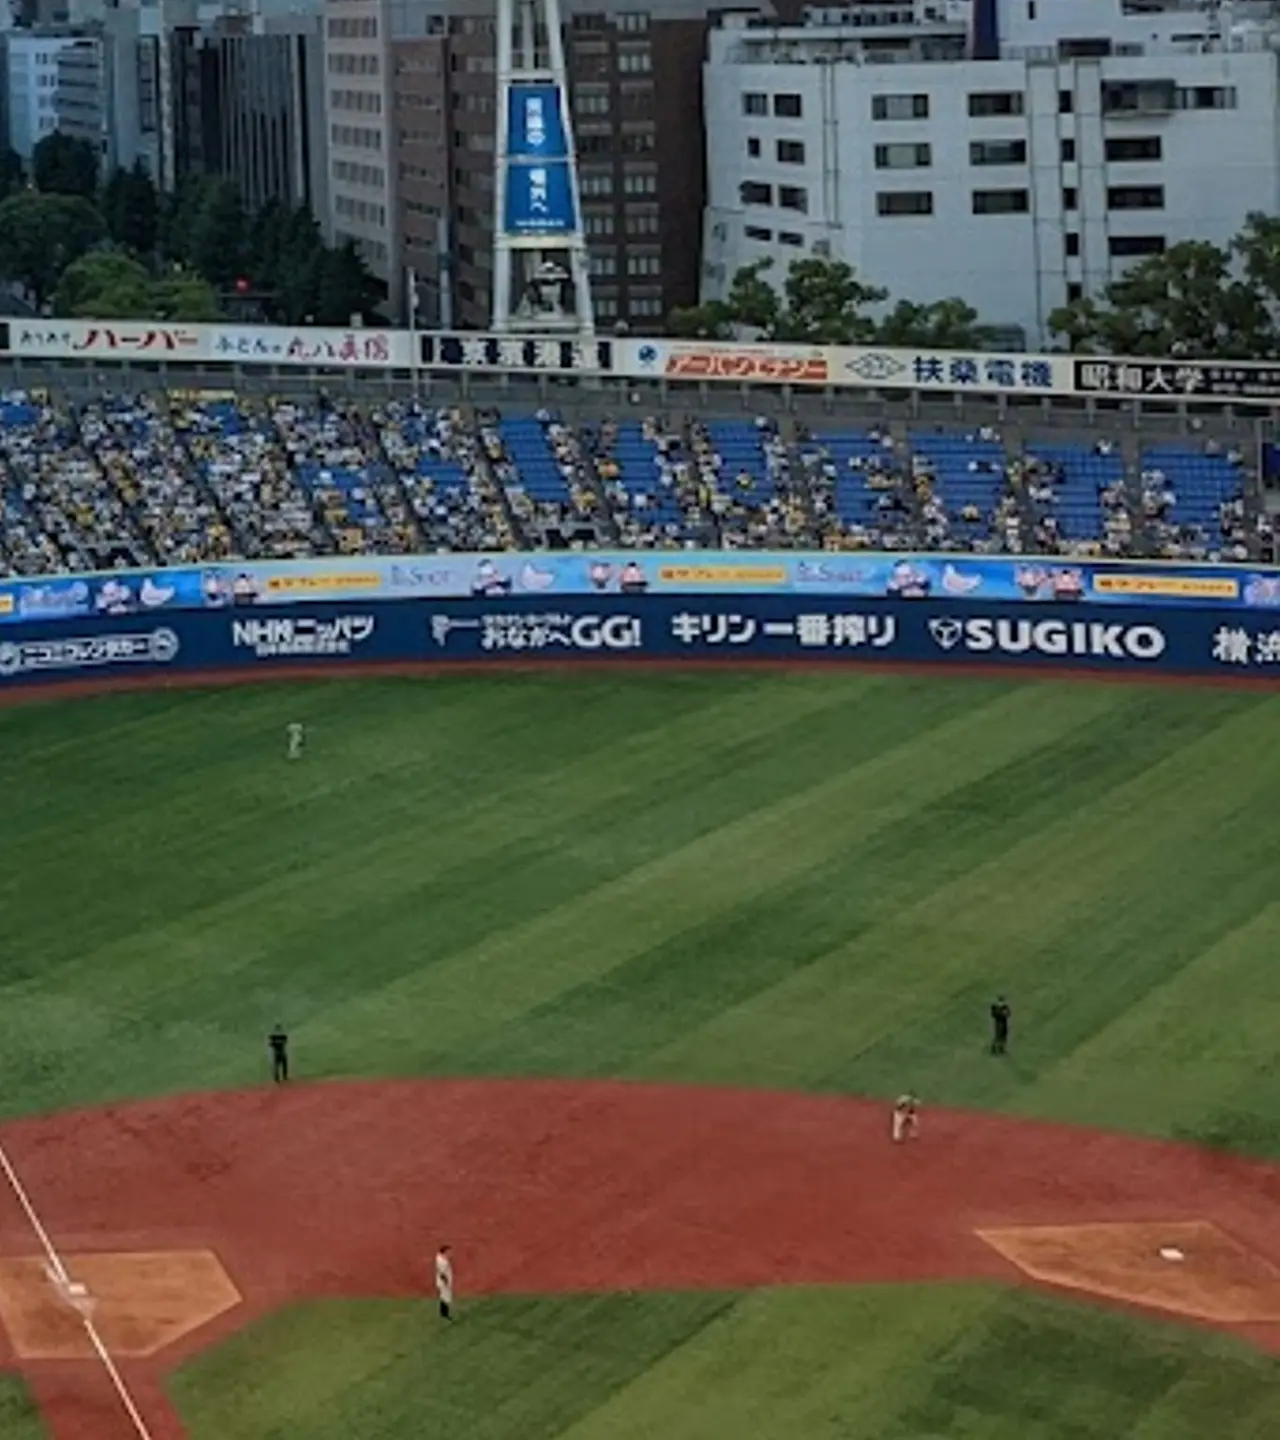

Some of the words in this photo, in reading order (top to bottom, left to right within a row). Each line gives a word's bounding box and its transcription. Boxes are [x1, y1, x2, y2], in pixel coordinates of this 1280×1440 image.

[912, 355, 1054, 388] 扶桑電機
[1080, 362, 1205, 393] 昭和大学
[963, 618, 1166, 659] SUGIKO
